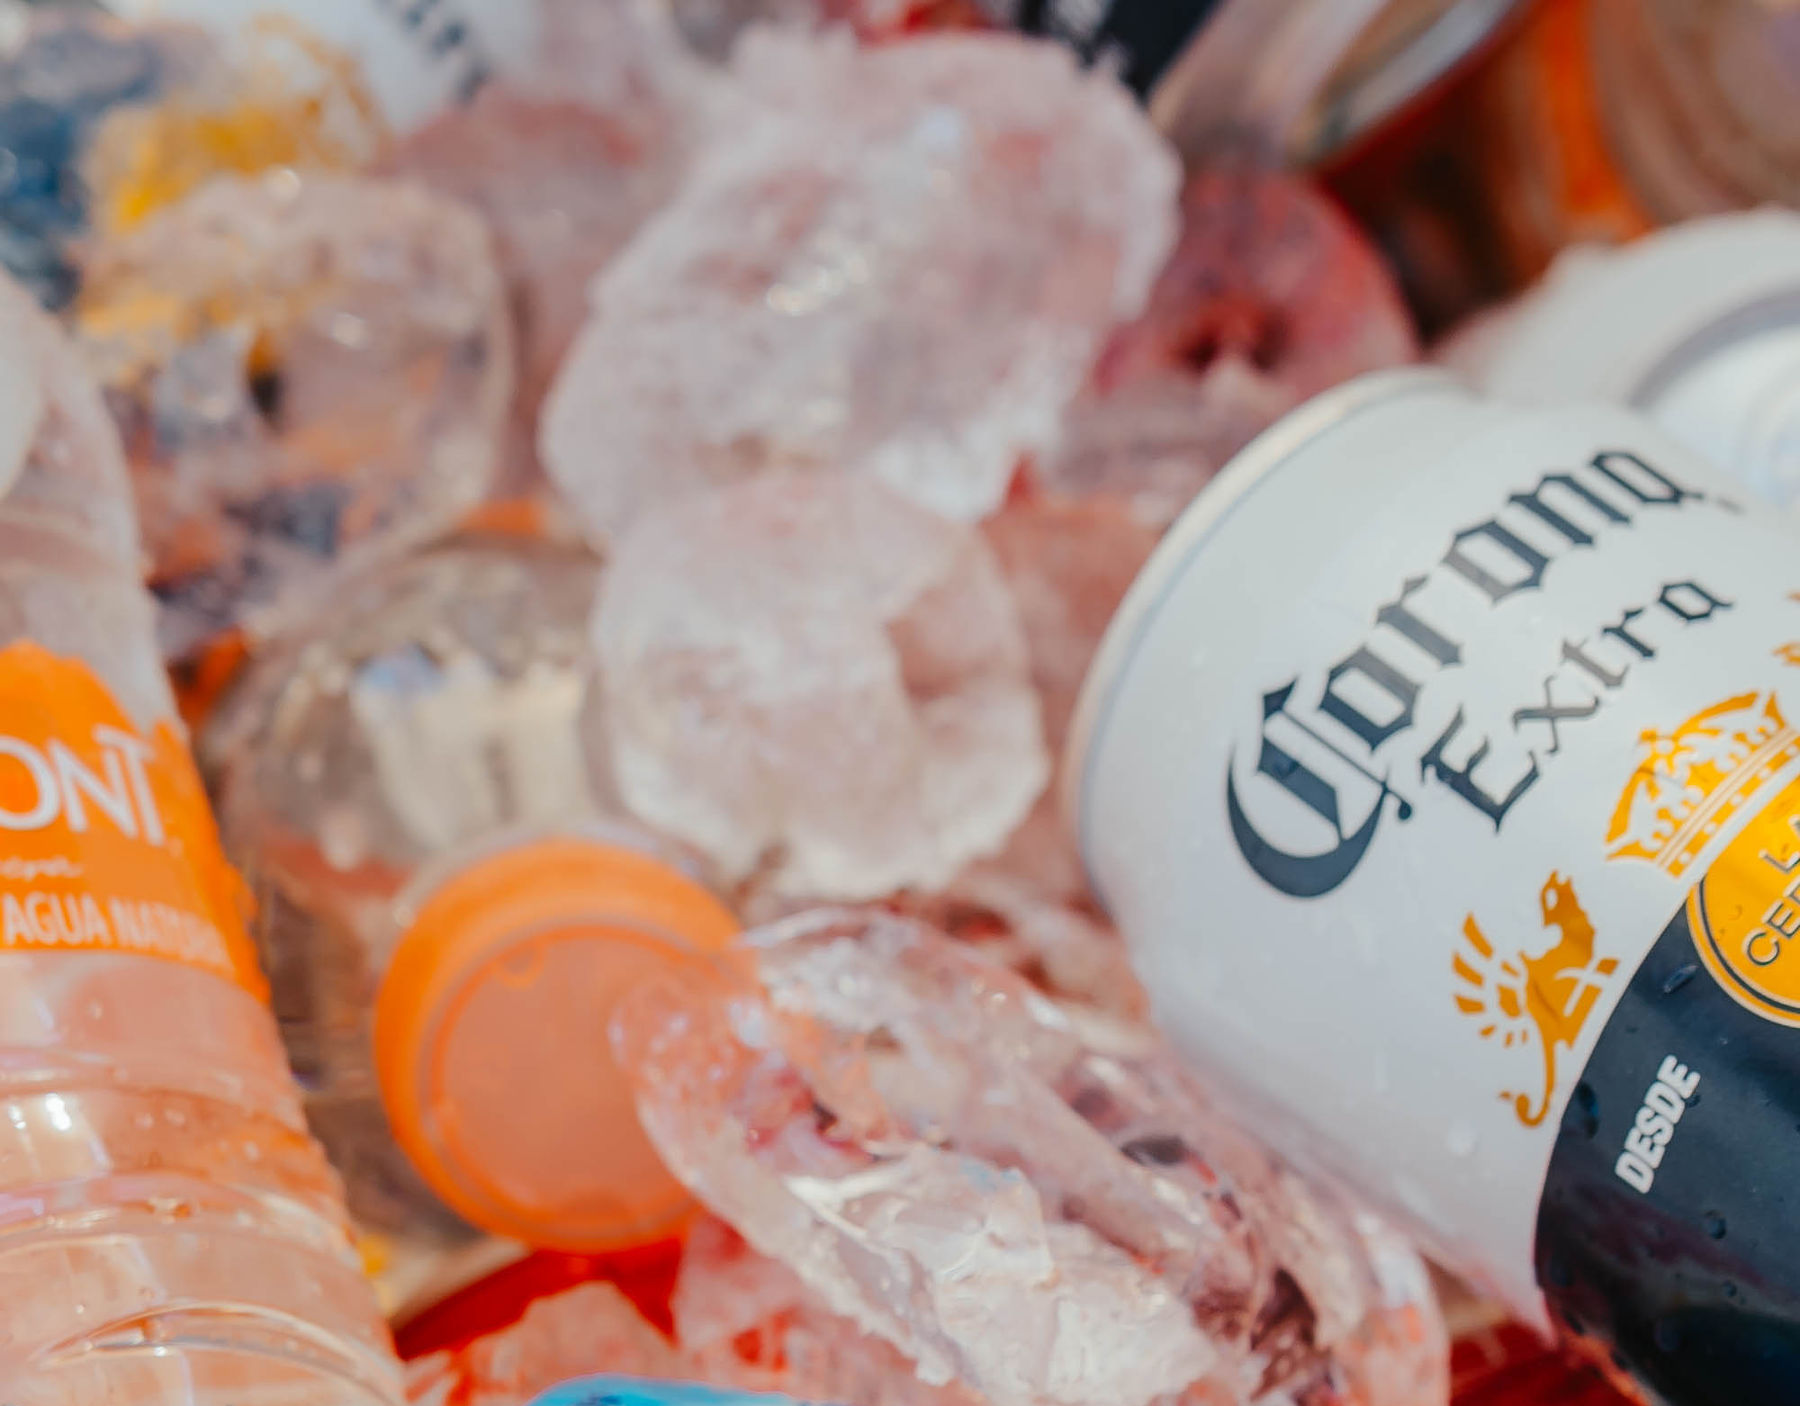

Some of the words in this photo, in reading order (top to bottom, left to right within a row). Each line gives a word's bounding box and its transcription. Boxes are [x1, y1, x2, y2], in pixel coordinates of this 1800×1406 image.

[1226, 448, 1706, 898] Corona
[1421, 577, 1734, 834] Extra
[3, 890, 110, 946] AGUA
[1614, 1054, 1701, 1195] DESDE
